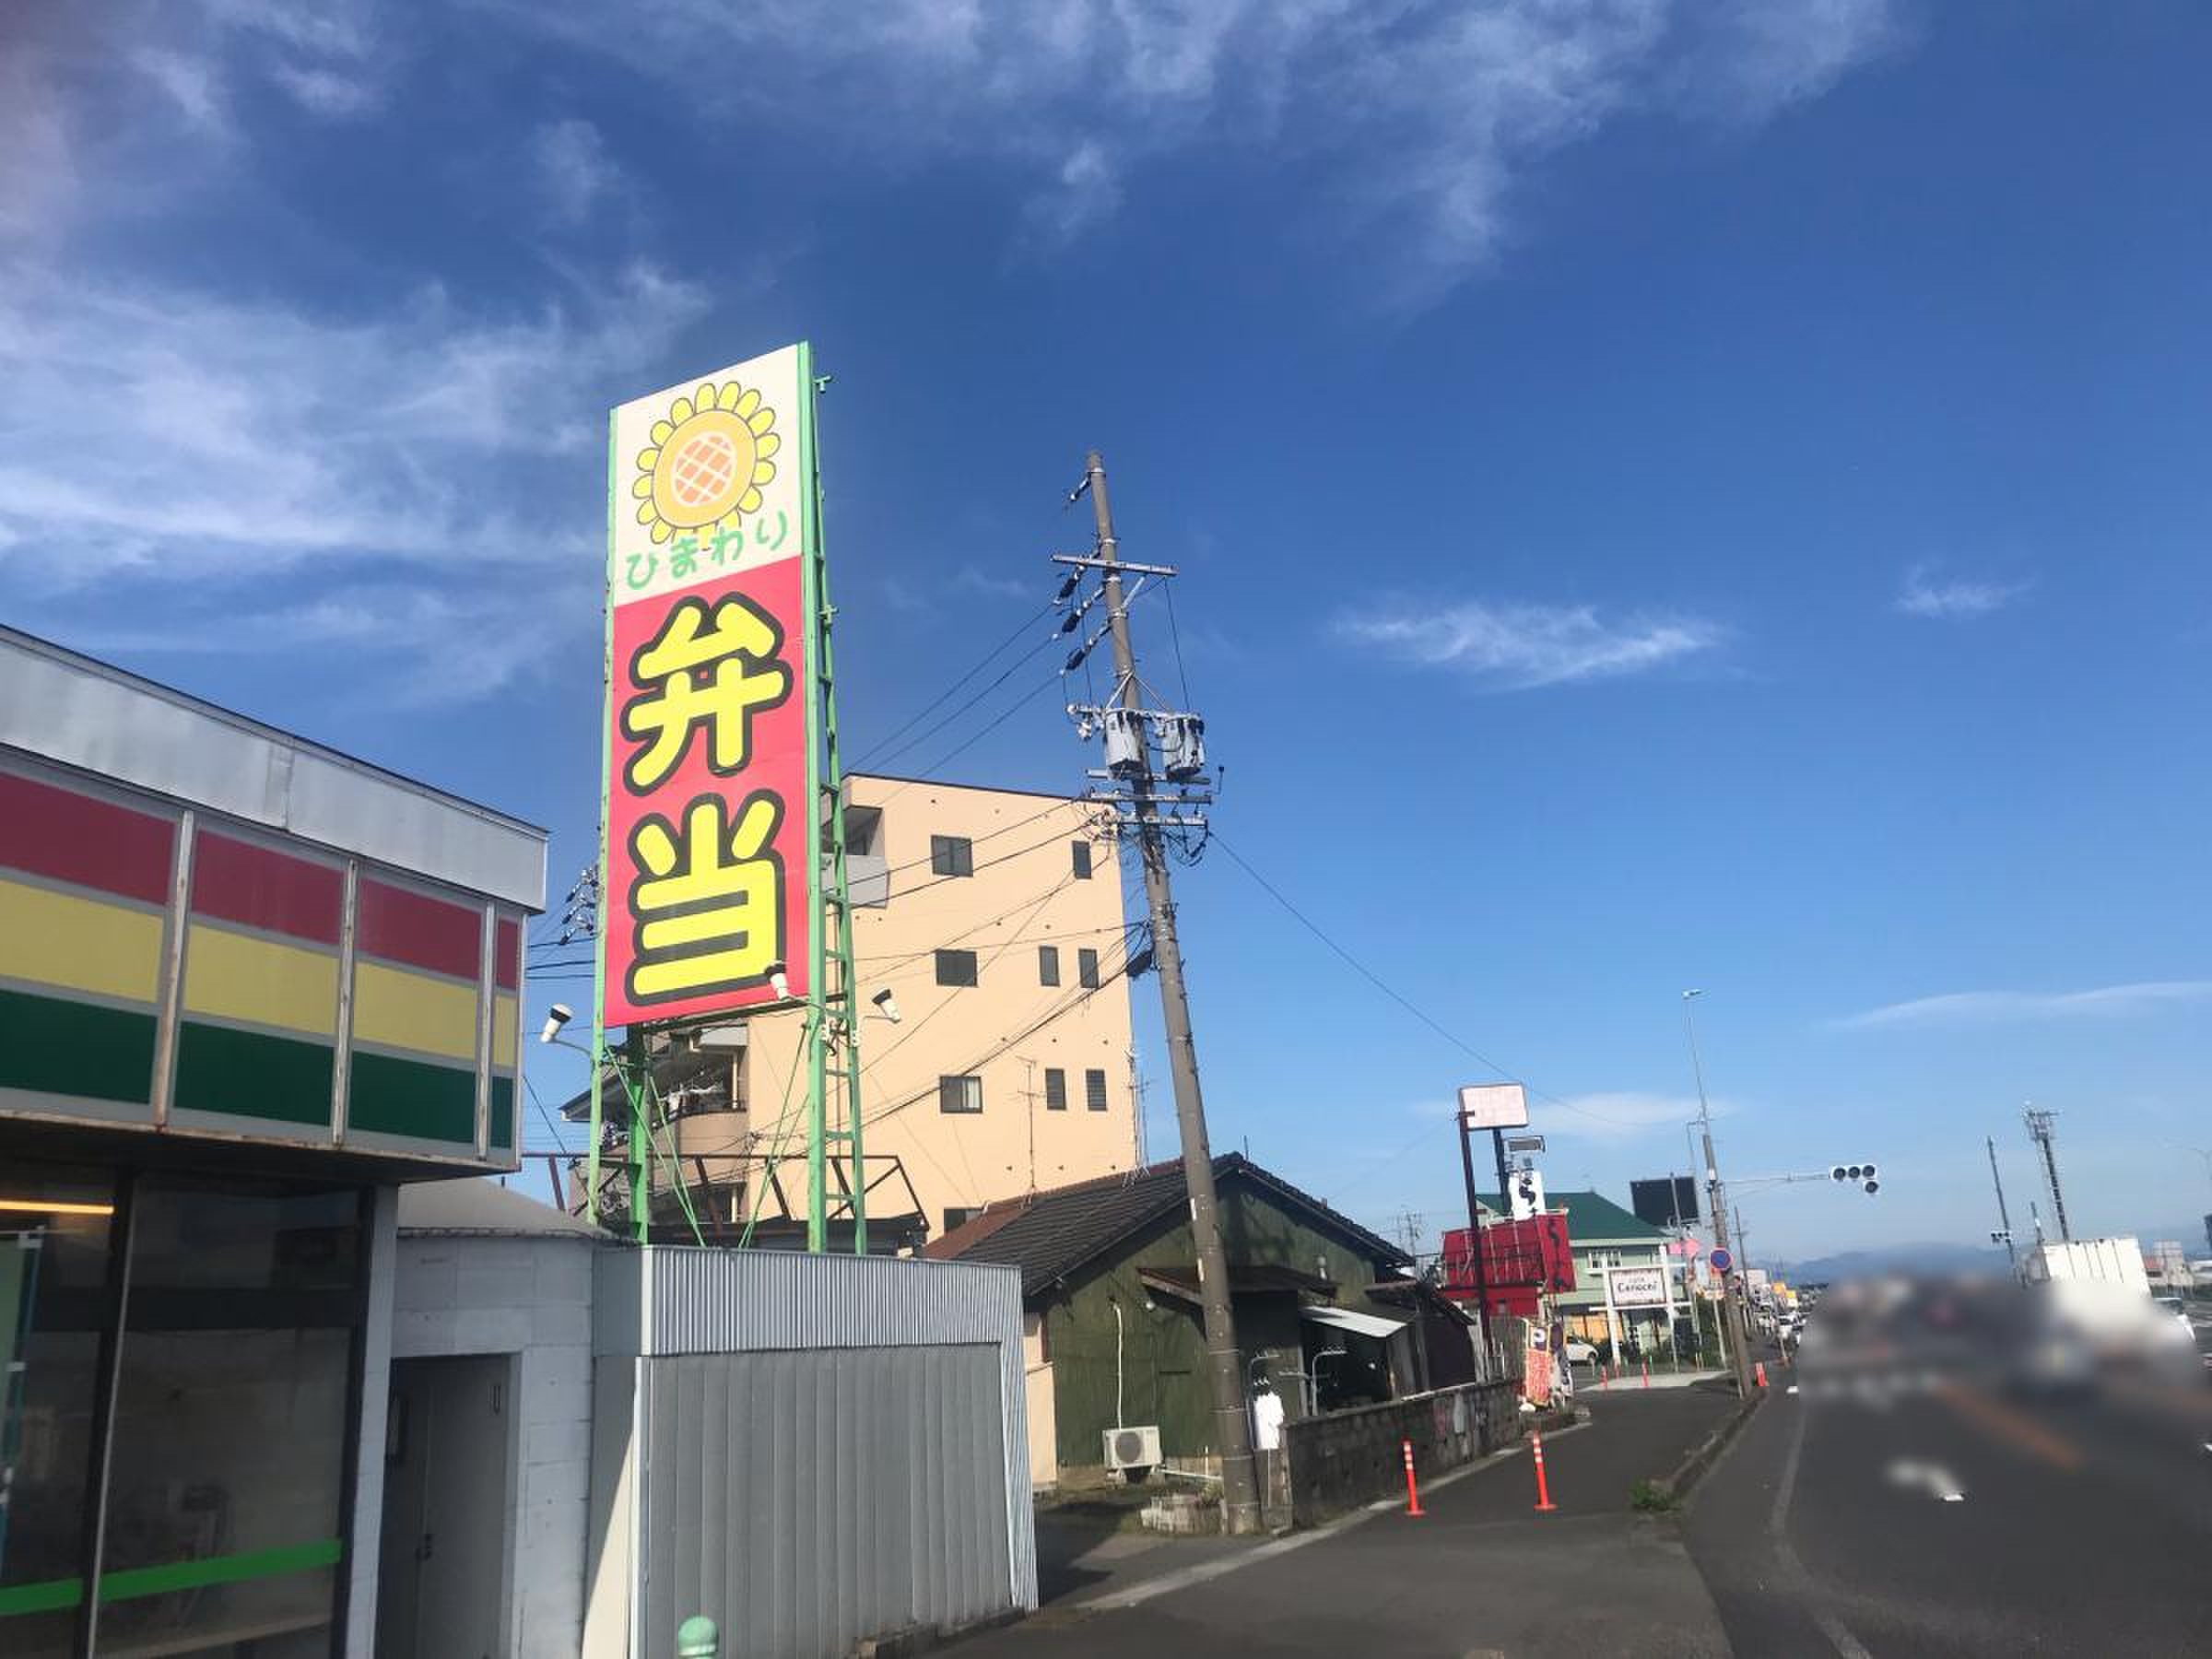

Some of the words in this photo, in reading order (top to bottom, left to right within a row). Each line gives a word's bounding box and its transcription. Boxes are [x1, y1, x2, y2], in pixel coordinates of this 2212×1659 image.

[626, 511, 788, 590] ひまわり
[621, 592, 794, 1006] 弁当
